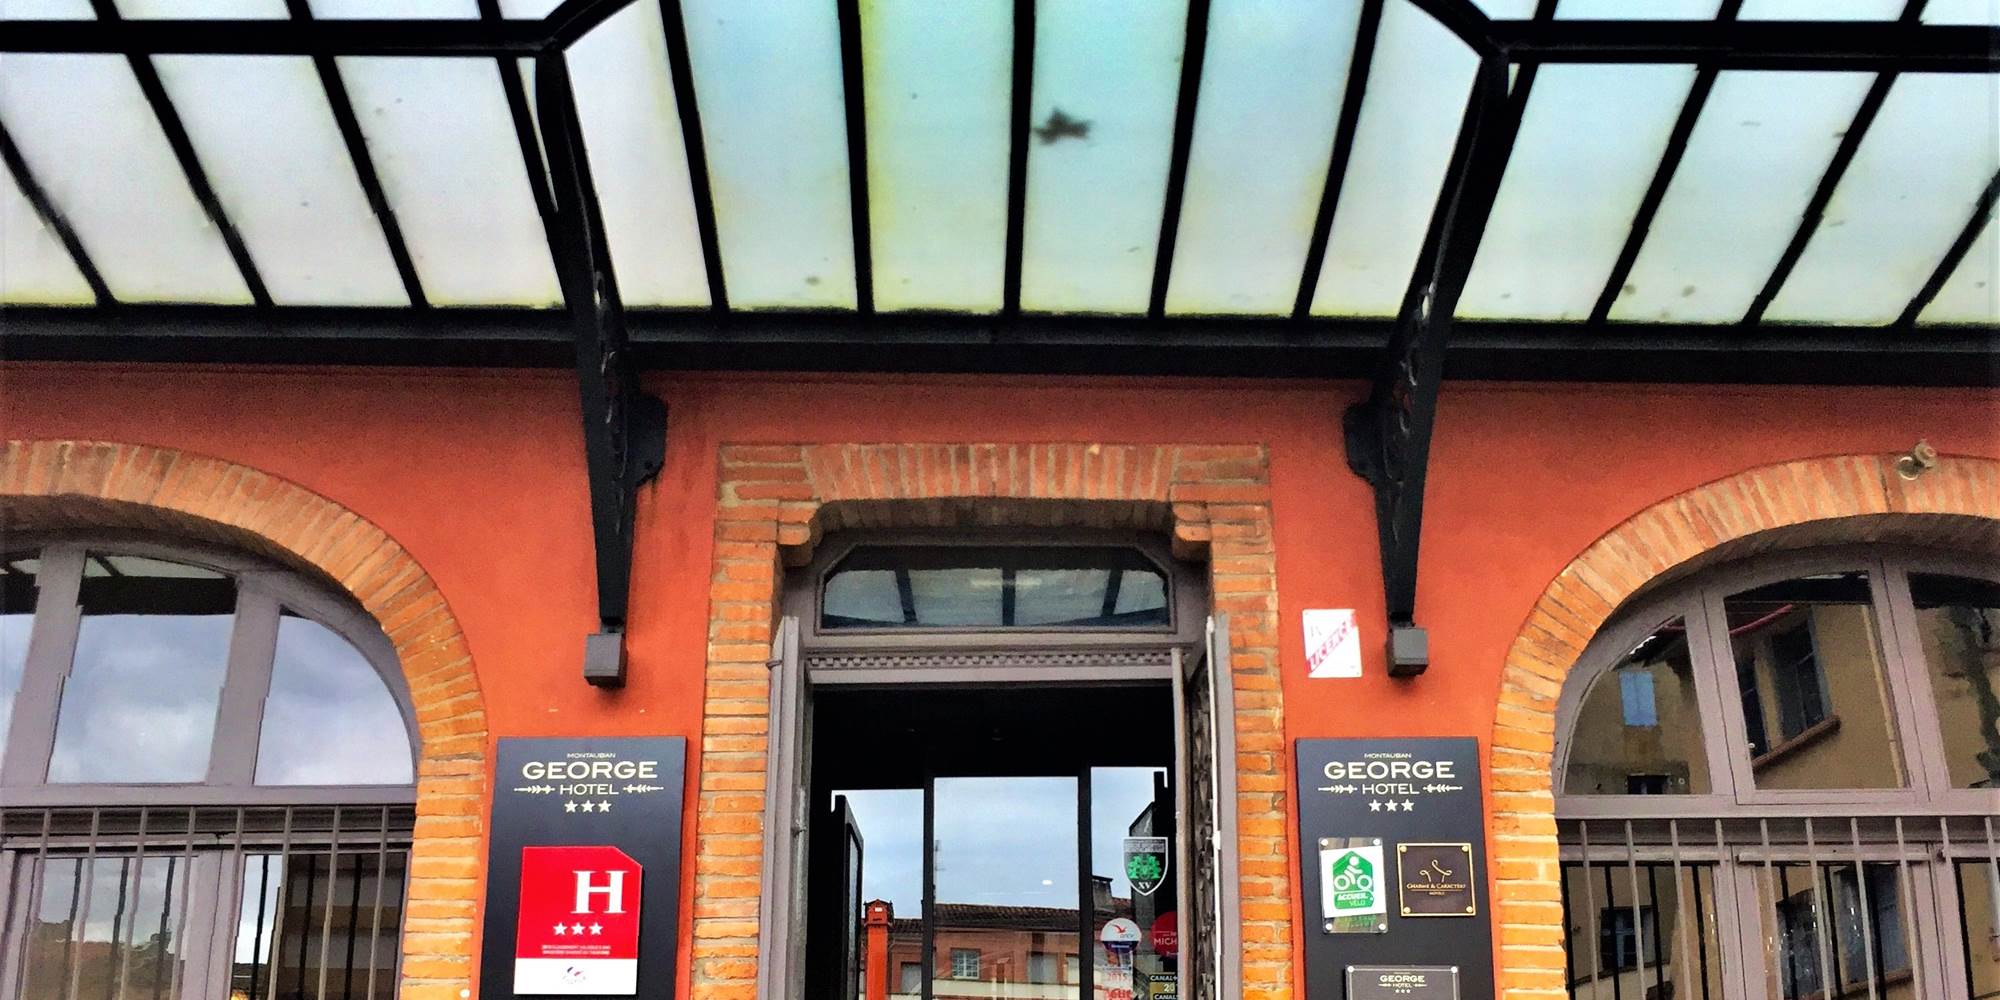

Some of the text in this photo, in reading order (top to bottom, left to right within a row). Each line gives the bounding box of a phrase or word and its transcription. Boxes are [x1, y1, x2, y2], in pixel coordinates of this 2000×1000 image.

[522, 761, 658, 780] GEORGE
[1323, 761, 1456, 780] GEORGE
[559, 783, 620, 795] HOTEL
[1362, 783, 1420, 795] HOTEL
[1138, 881, 1152, 889] XV
[570, 870, 629, 915] H
[1379, 974, 1425, 983] GEORGE
